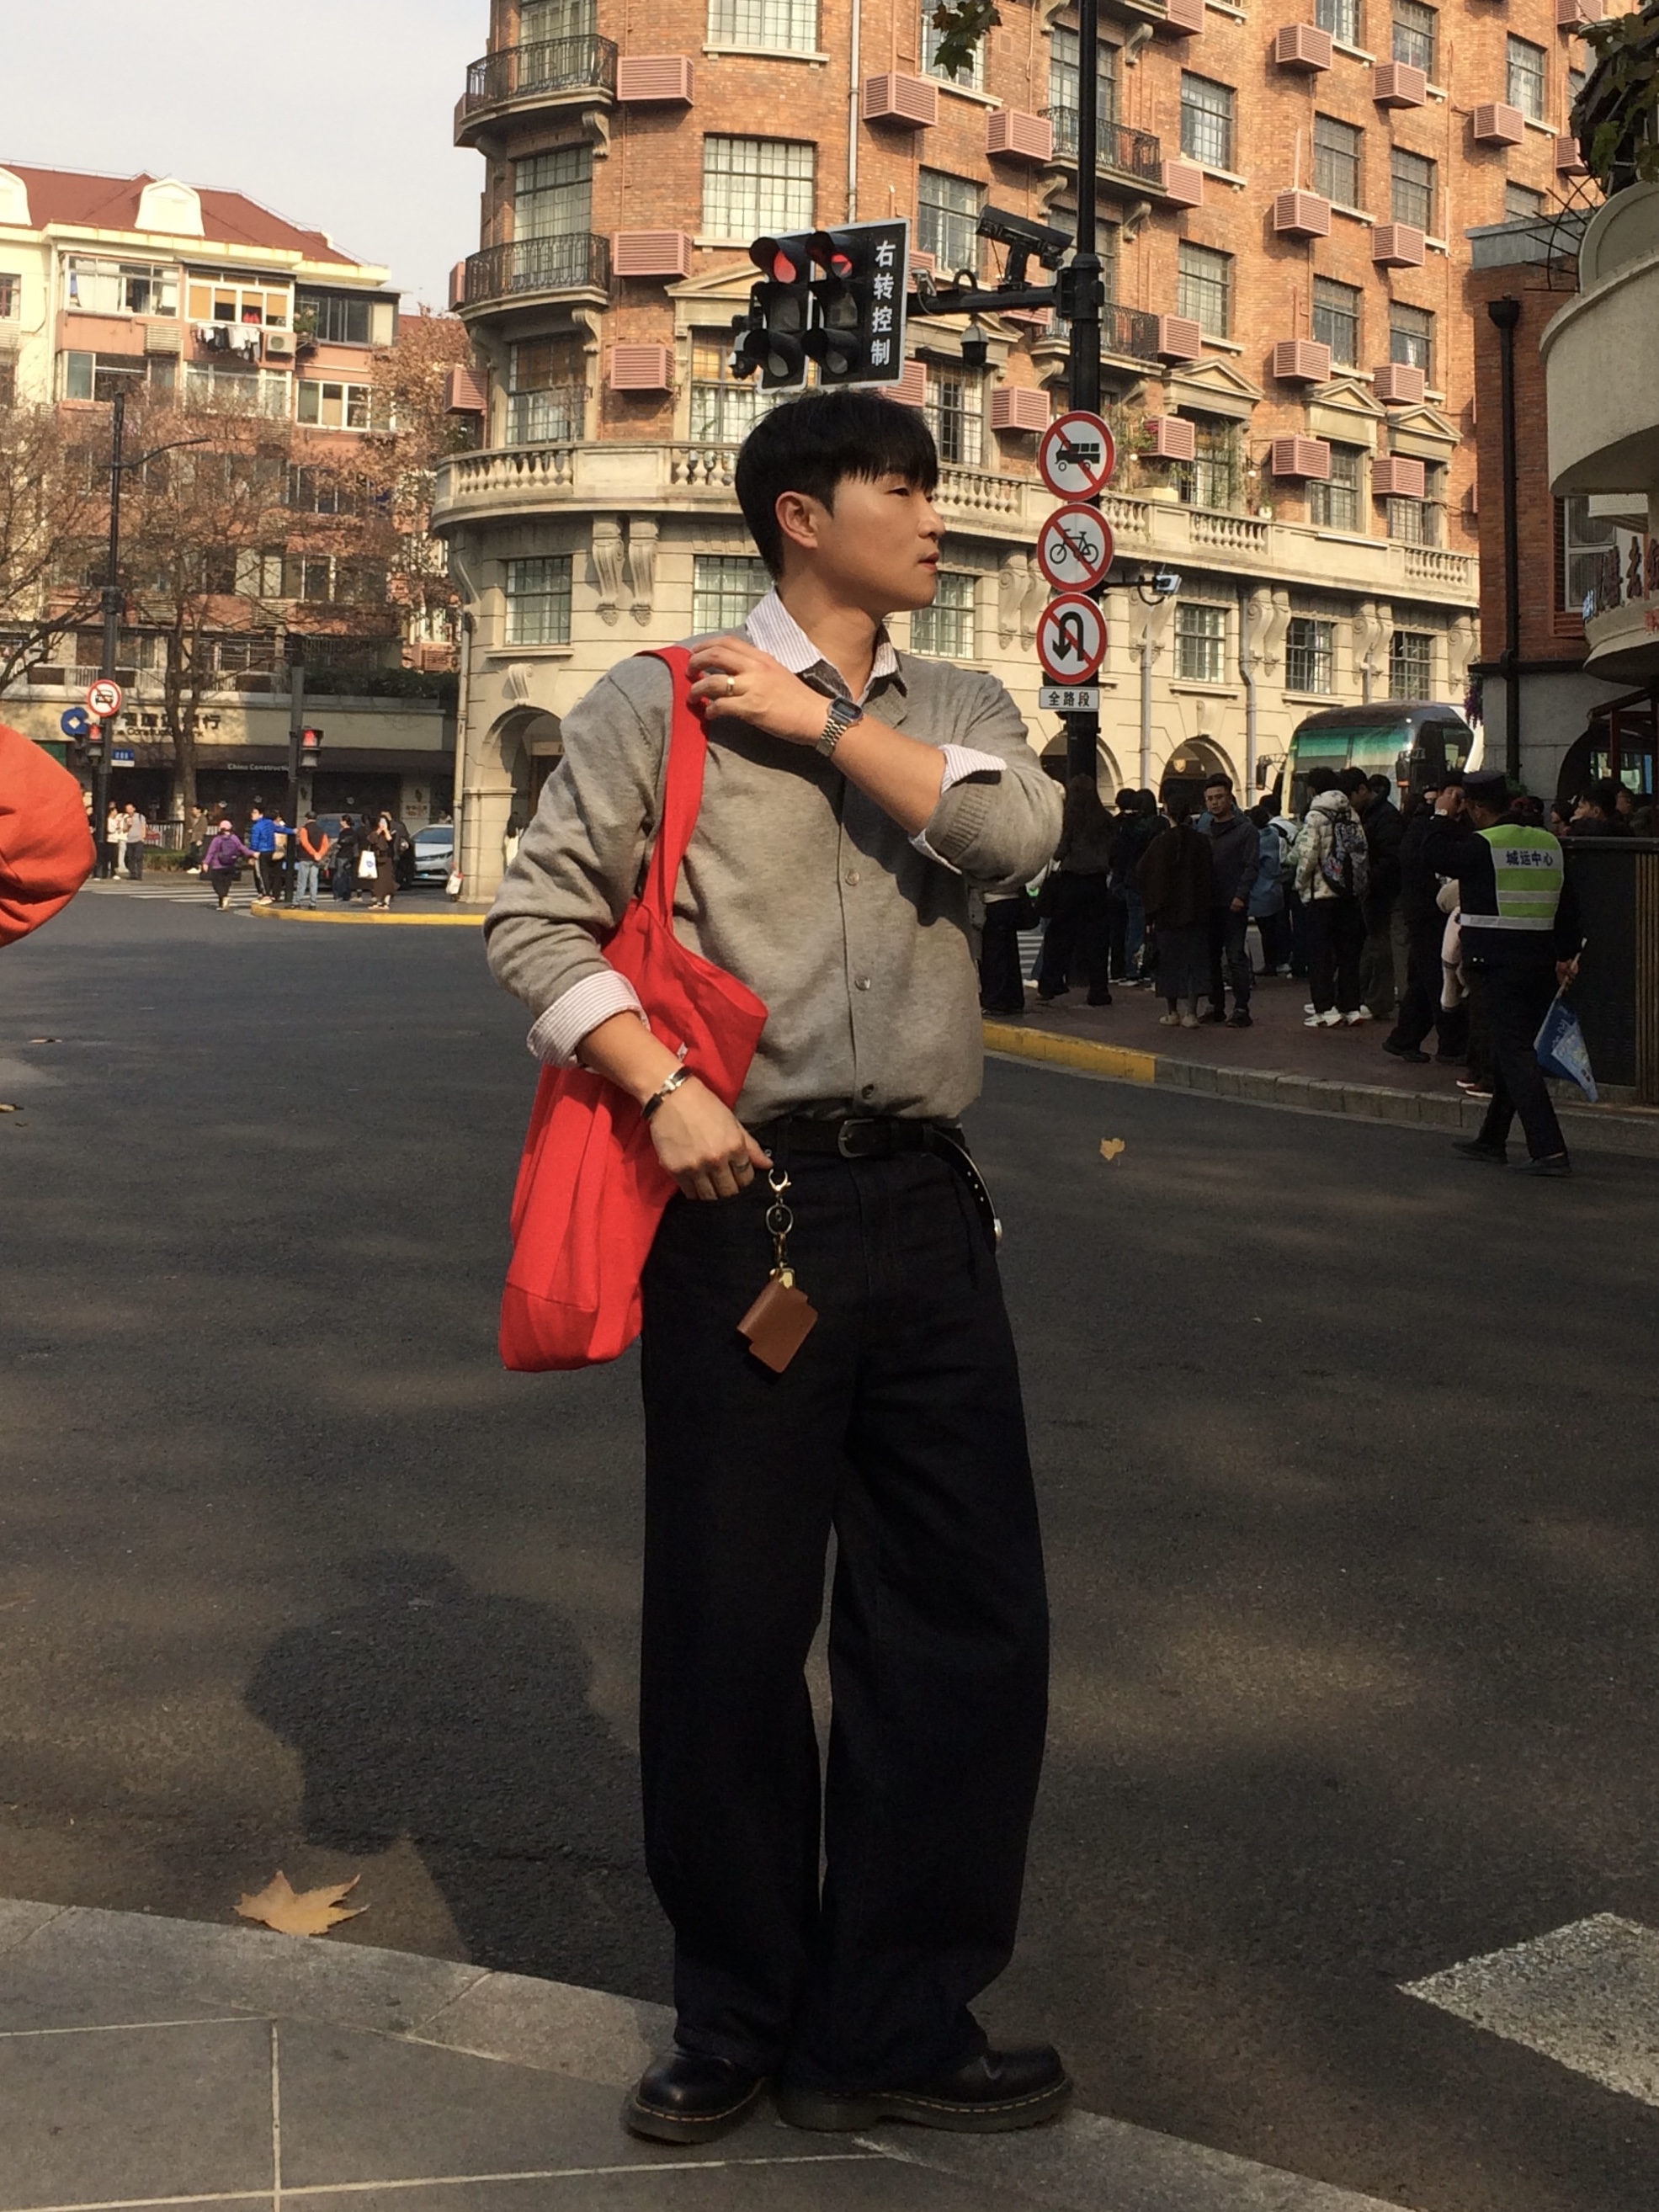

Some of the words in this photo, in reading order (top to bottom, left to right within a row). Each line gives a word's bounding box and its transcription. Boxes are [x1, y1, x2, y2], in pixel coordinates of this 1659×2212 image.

[870, 240, 896, 367] 右转控制
[1048, 691, 1090, 707] 全路段
[1506, 850, 1554, 867] 城运中心
